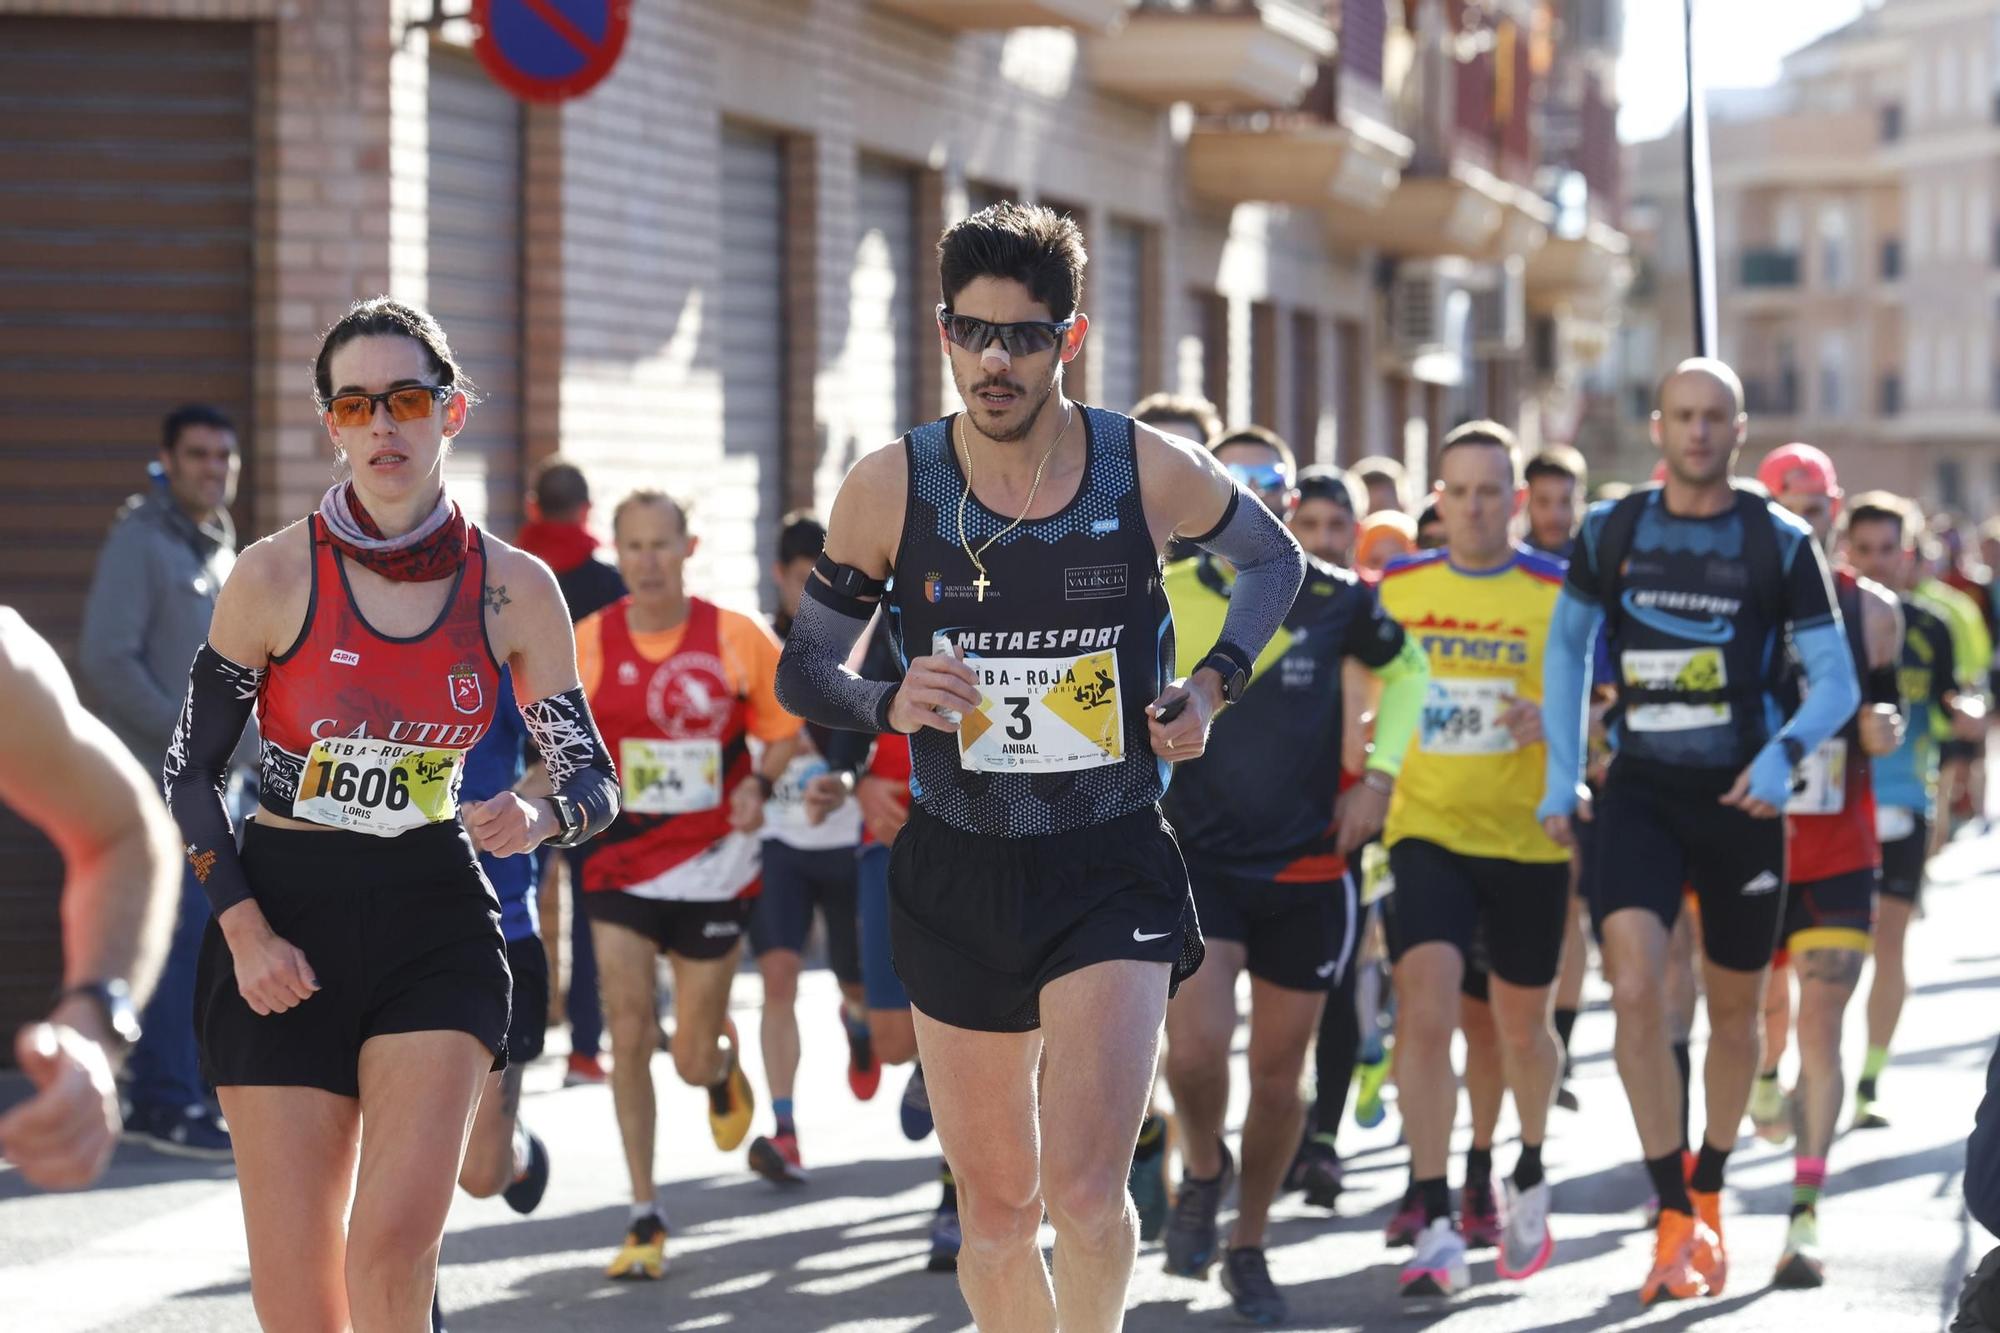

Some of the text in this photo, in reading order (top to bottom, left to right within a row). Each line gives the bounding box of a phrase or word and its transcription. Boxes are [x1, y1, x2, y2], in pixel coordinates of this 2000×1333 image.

[957, 624, 1124, 651] METAESPORT
[1004, 697, 1032, 741] 3
[1002, 744, 1039, 755] ANIBAL
[315, 761, 409, 811] 1606
[342, 804, 372, 820] LORIS
